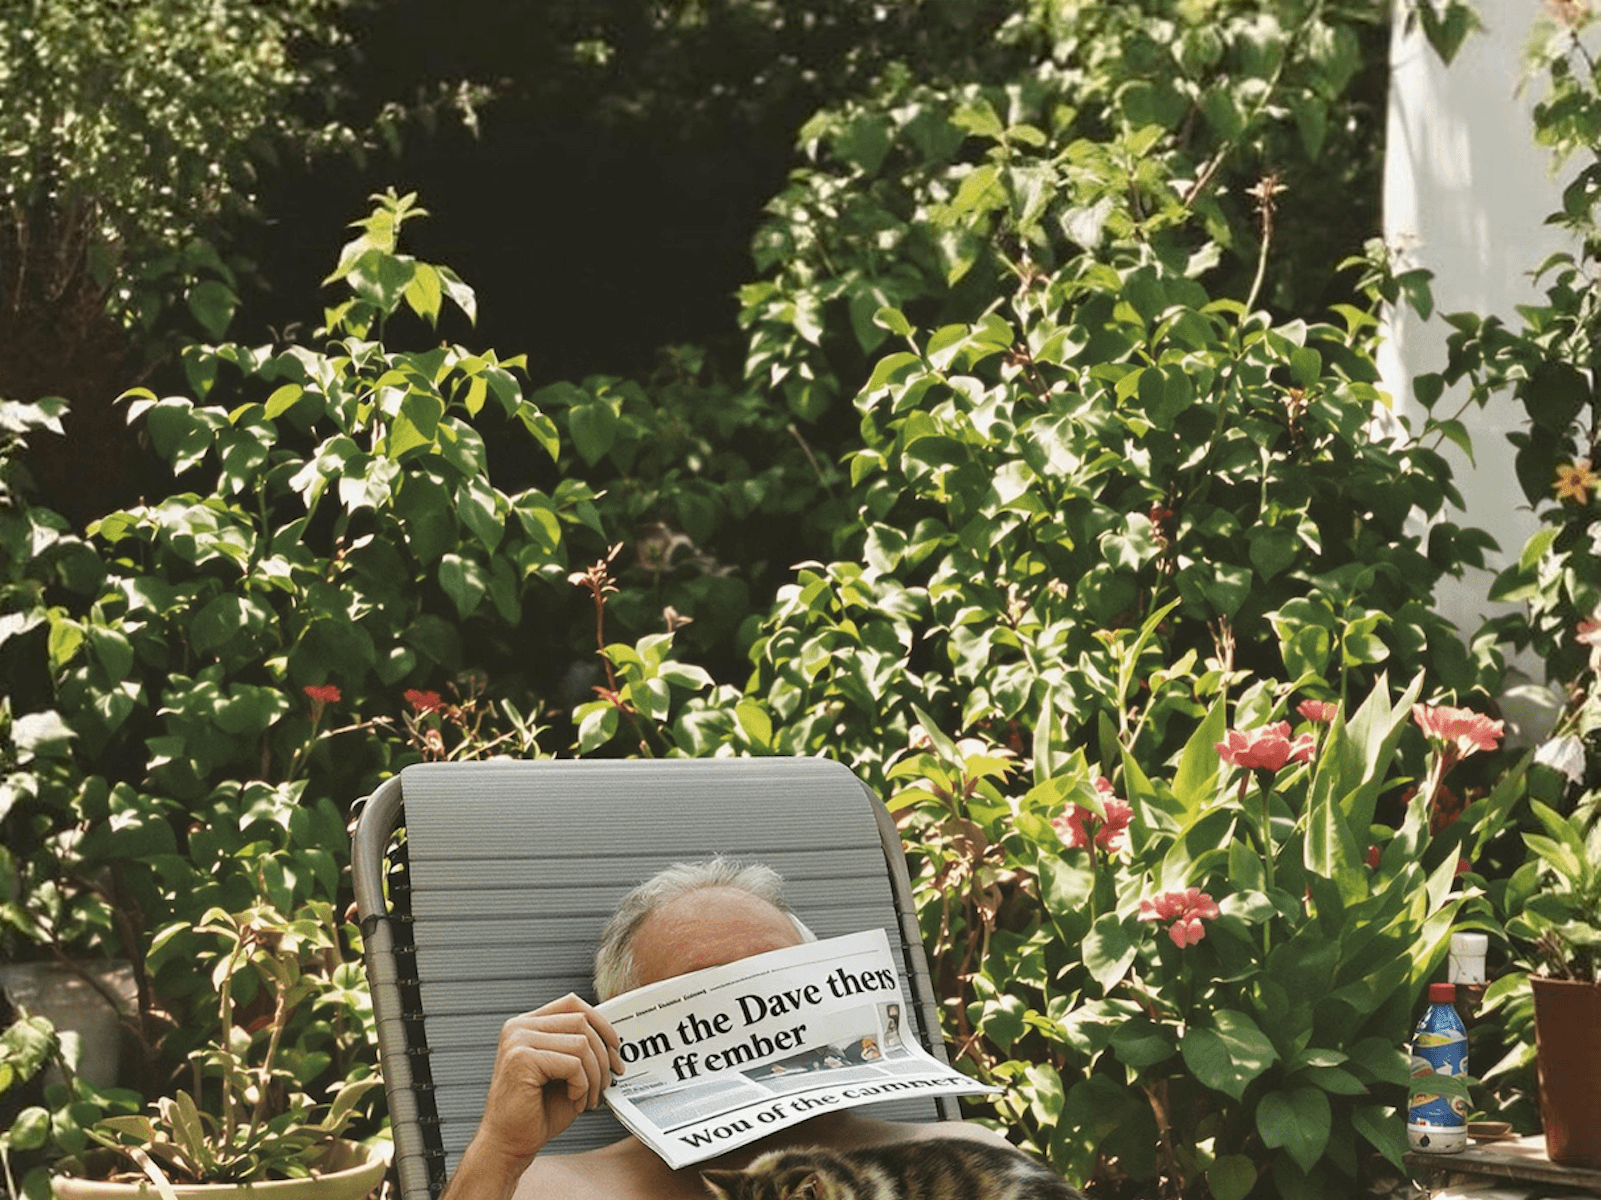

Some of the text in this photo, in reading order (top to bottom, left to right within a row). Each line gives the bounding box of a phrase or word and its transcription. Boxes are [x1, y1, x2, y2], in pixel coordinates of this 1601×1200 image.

[619, 1031, 675, 1063] om
[676, 1012, 734, 1046] the
[735, 984, 823, 1027] Dave
[756, 1102, 789, 1124] of
[790, 1093, 840, 1112] the
